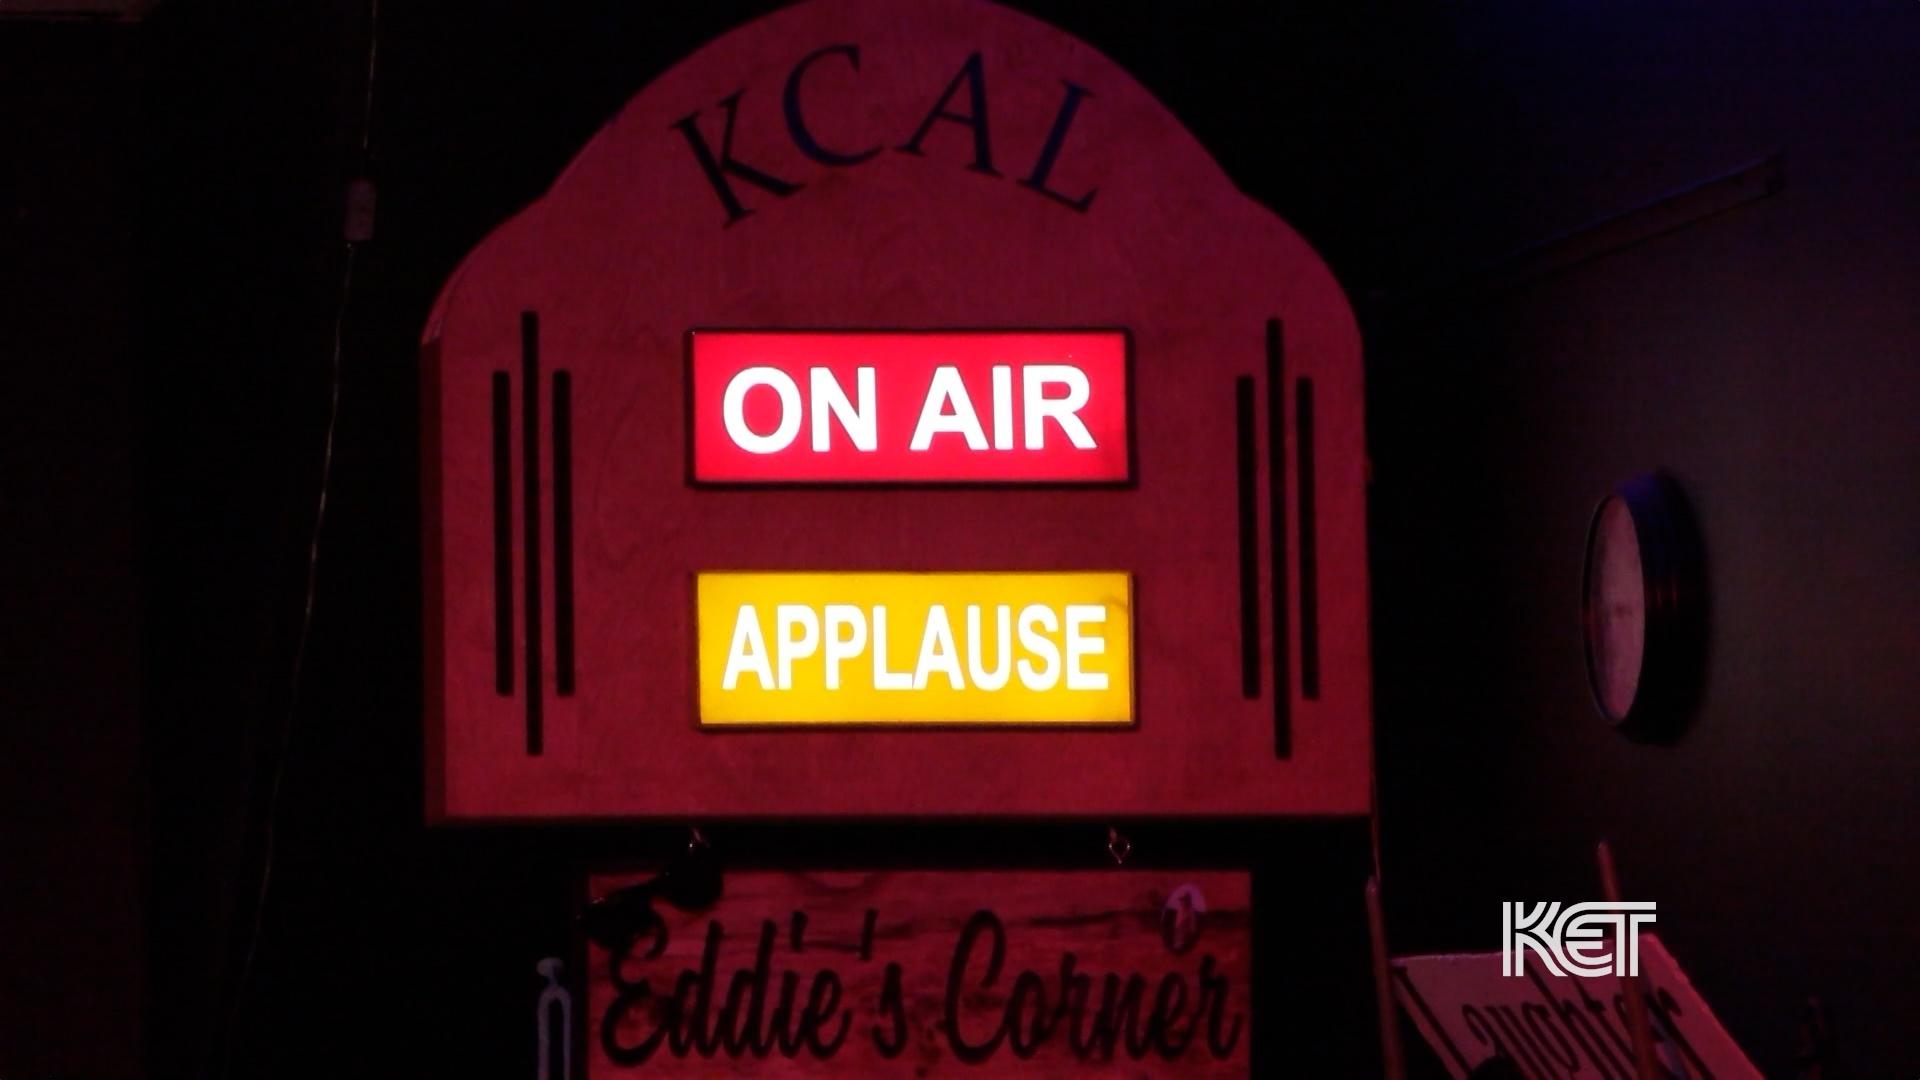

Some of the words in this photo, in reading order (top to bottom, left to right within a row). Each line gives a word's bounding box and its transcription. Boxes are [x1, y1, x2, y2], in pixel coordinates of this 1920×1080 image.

[668, 44, 1099, 229] KCAL
[722, 365, 878, 454] ON
[908, 364, 1098, 451] AIR
[722, 604, 1110, 691] APPLAUSE
[600, 905, 906, 1067] Eddie's
[945, 910, 1245, 1064] Corner
